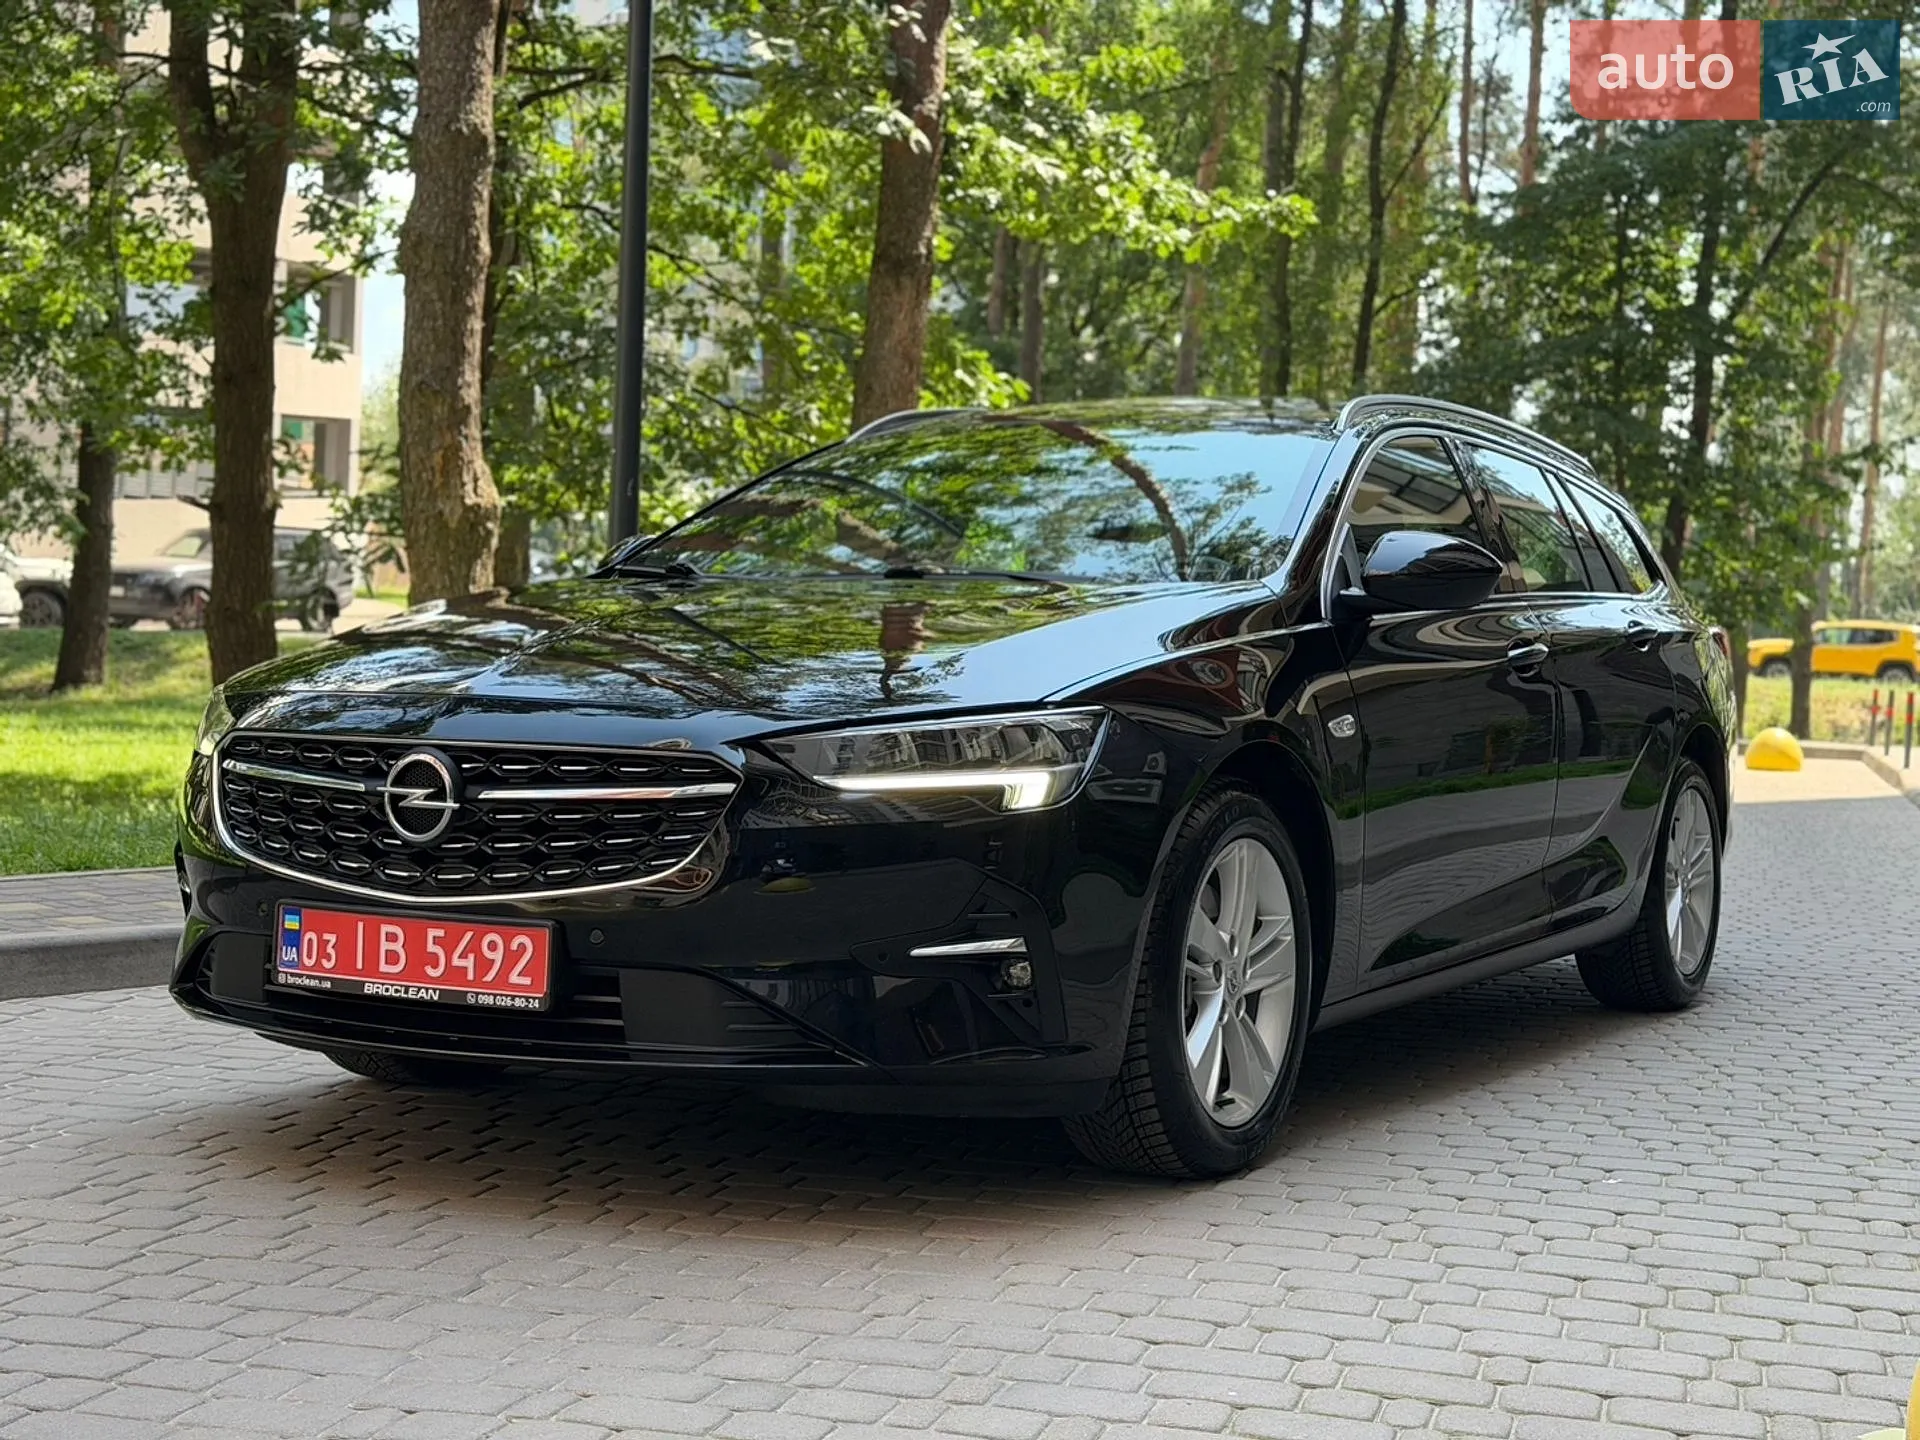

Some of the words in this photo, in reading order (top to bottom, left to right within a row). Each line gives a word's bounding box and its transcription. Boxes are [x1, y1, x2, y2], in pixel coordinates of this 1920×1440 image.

[282, 946, 298, 962] UA
[302, 931, 338, 969] 03
[356, 921, 407, 974] IB
[424, 928, 534, 986] 5492
[287, 974, 331, 989] broclean.ua
[363, 983, 440, 1001] BROCLEAN
[477, 994, 494, 1005] 098
[495, 996, 539, 1008] 026-80-24
